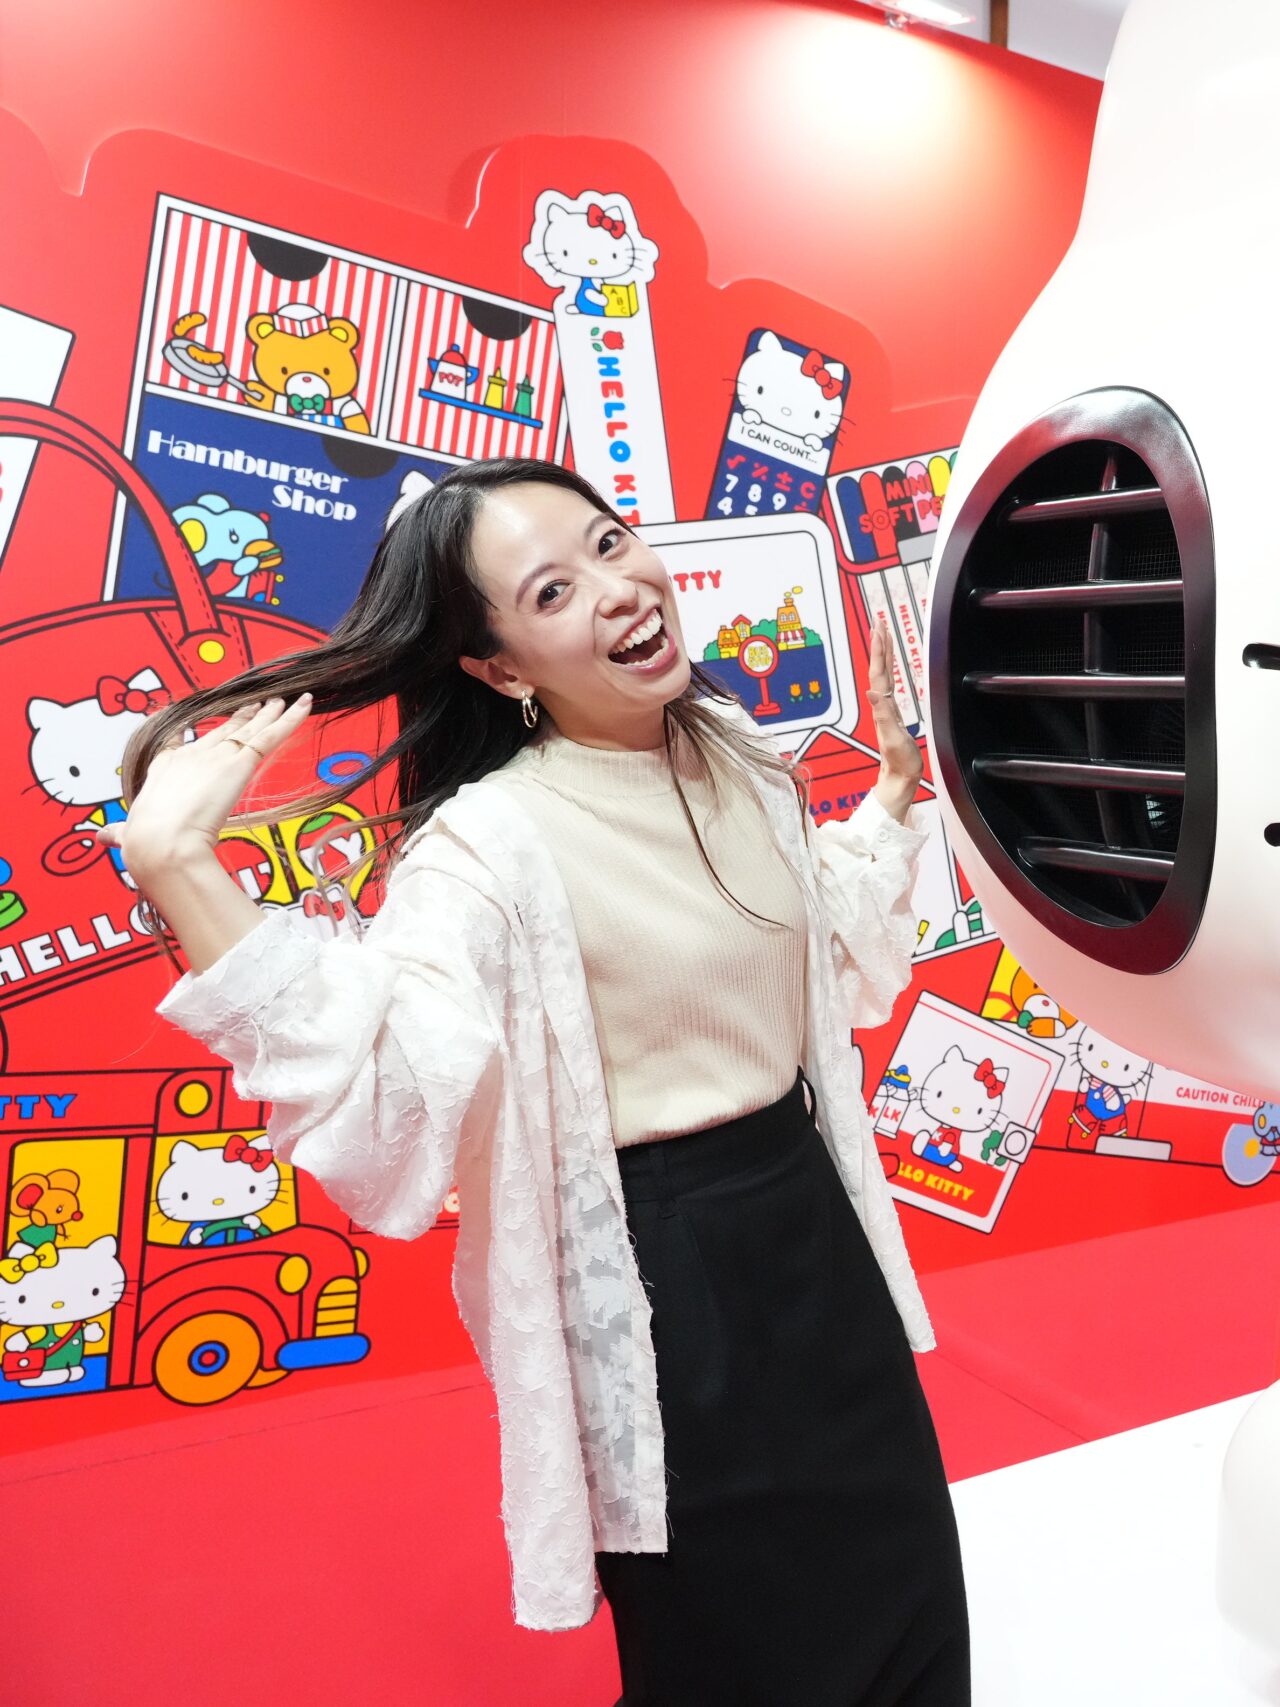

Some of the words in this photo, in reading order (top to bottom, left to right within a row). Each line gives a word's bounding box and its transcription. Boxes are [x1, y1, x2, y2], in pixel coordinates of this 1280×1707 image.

[438, 372, 464, 387] POT
[597, 357, 631, 463] HELLO
[740, 426, 745, 435] I
[747, 429, 771, 445] CAN
[147, 430, 348, 494] Hamburger
[272, 485, 357, 521] Shop
[613, 474, 641, 526] KIT
[886, 473, 933, 502] MINI
[859, 503, 914, 534] SOFT
[916, 495, 945, 521] PE
[673, 569, 722, 592] TTY
[899, 604, 916, 645] HELLO
[910, 648, 924, 671] KIT
[892, 655, 906, 695] ITTY
[0, 1093, 78, 1120] TTY
[1176, 1086, 1229, 1104] CAUTION
[897, 1161, 925, 1183] LLO
[925, 1174, 975, 1201] KITTY
